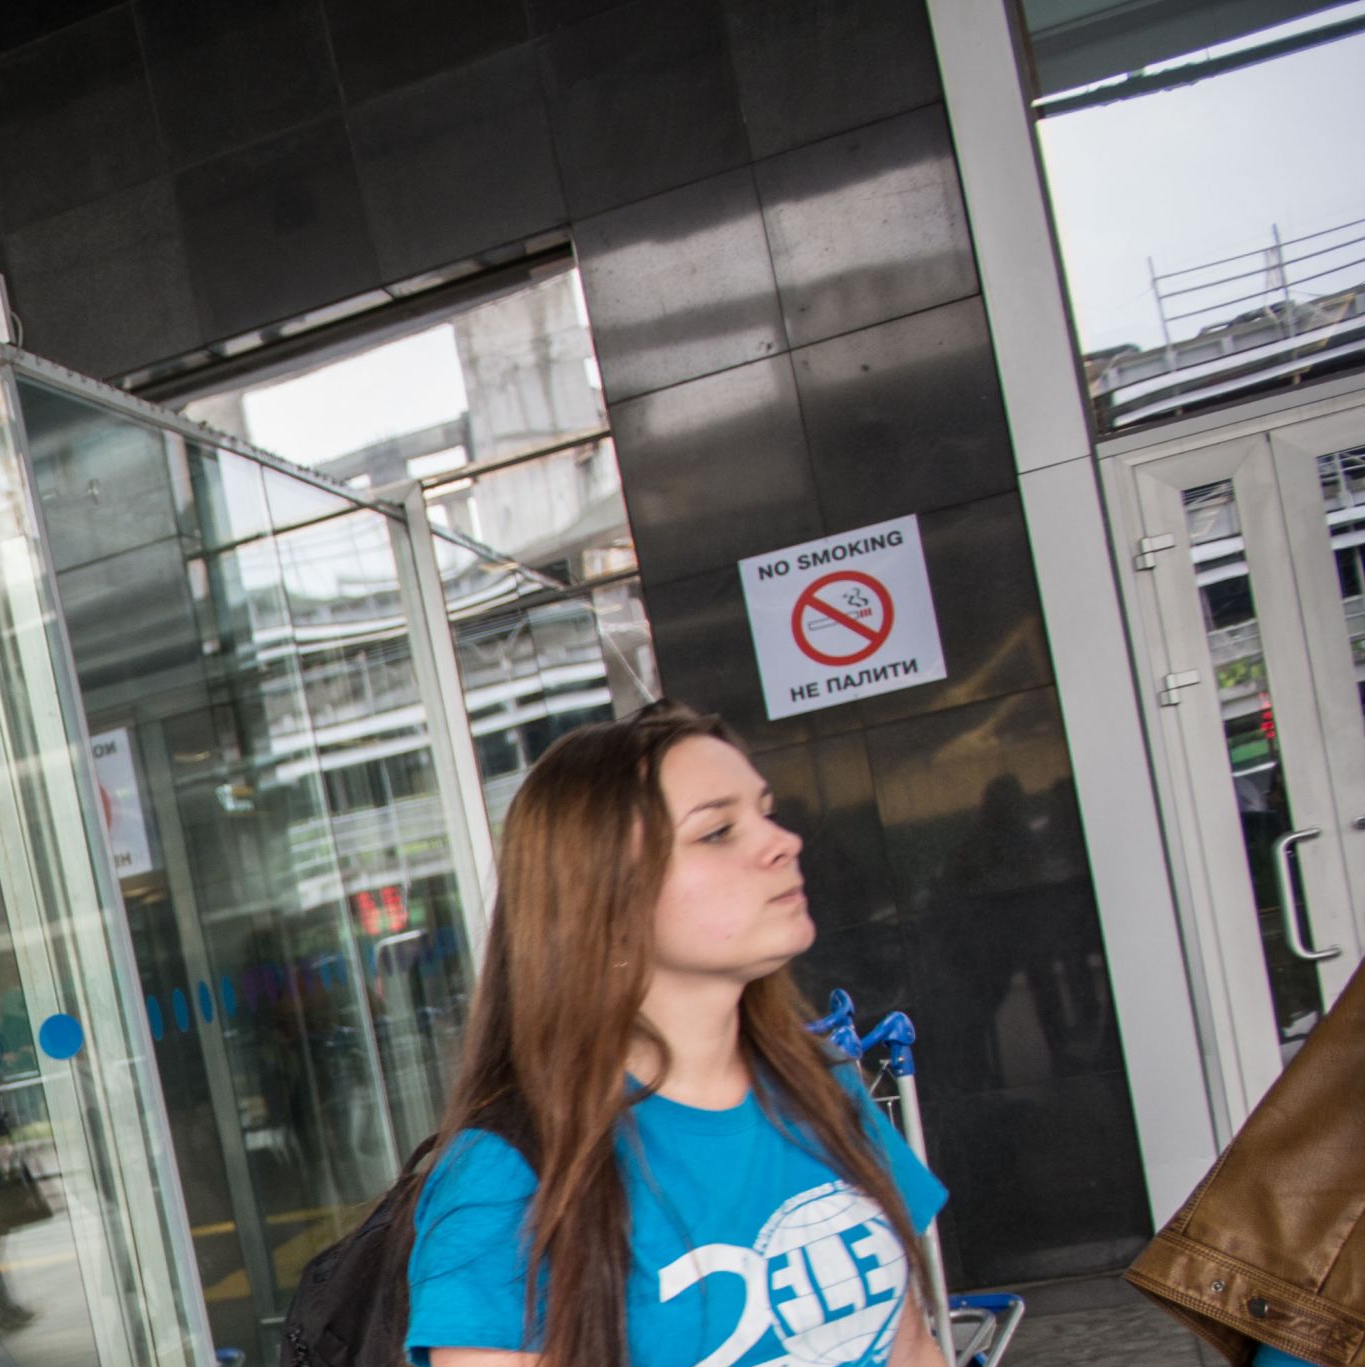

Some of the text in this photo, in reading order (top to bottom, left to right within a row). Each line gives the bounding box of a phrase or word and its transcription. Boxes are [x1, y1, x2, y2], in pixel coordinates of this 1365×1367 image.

[758, 530, 903, 581] NO SMOKING
[790, 657, 919, 703] НЕ ПАЛИТИ
